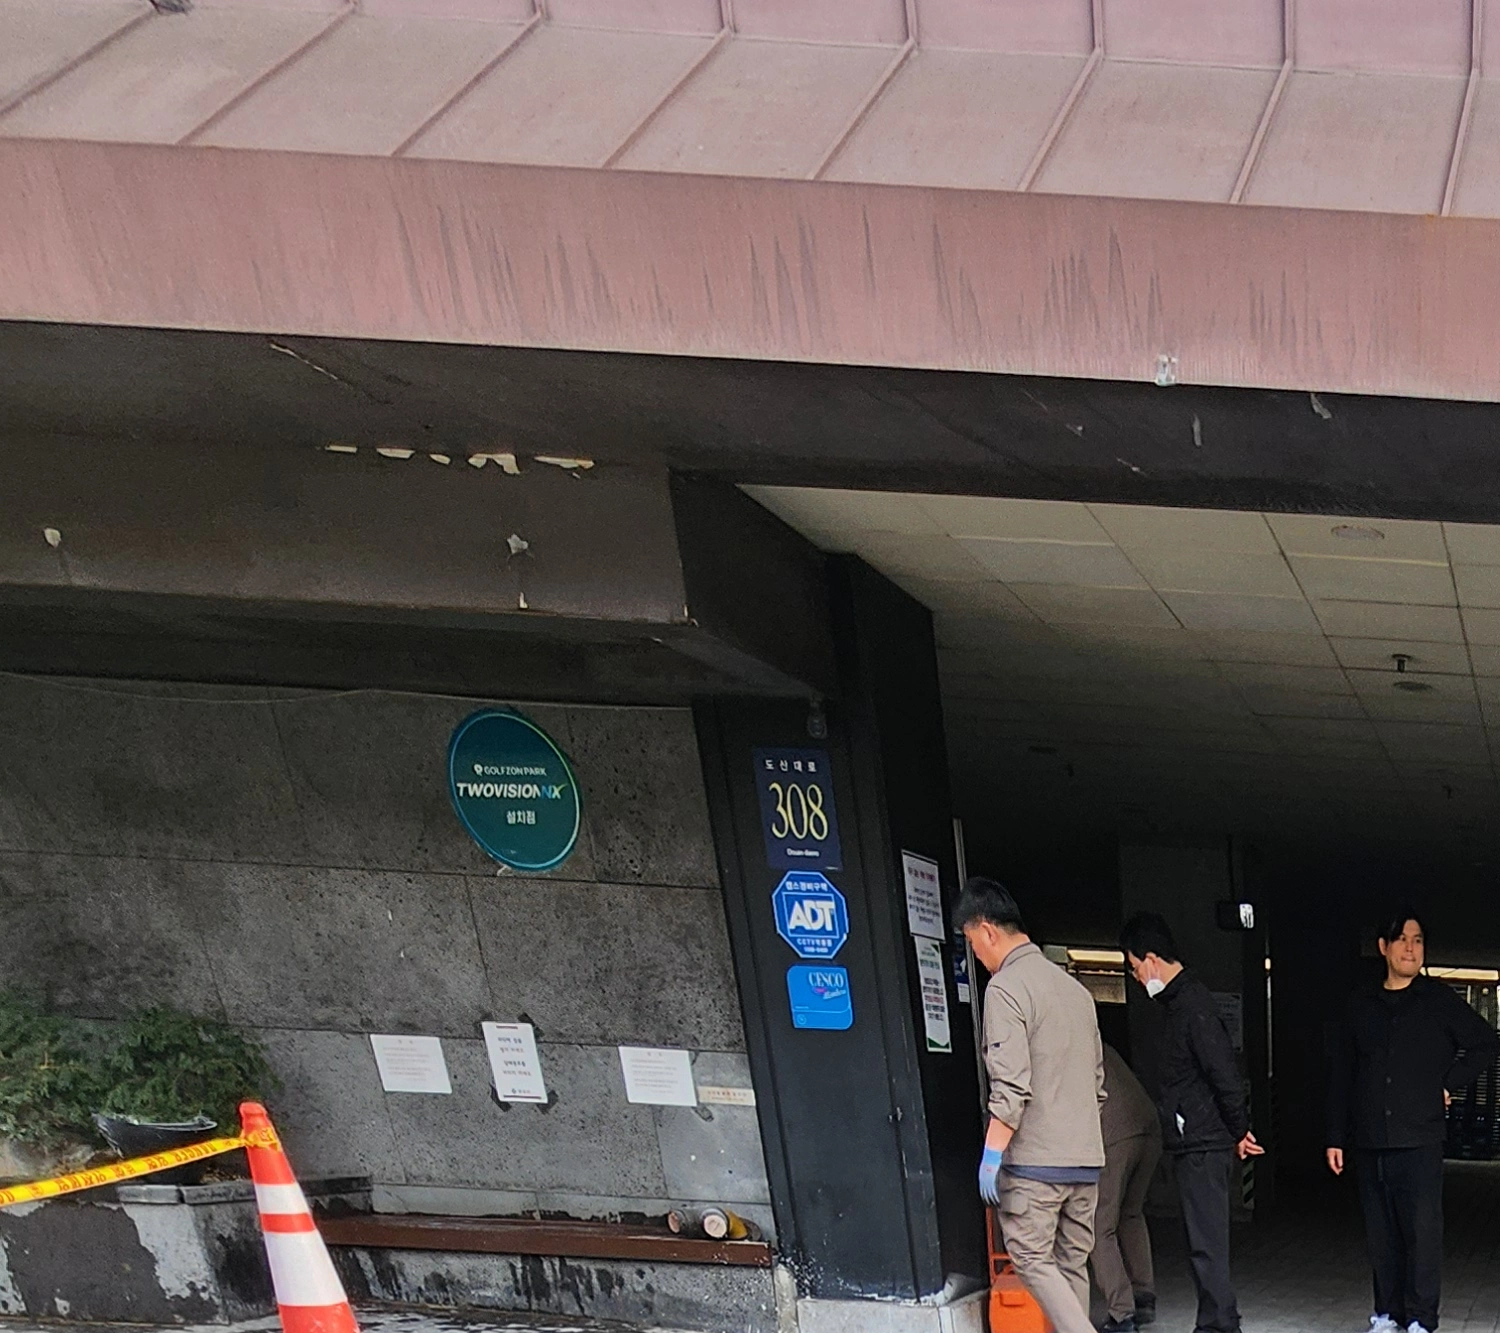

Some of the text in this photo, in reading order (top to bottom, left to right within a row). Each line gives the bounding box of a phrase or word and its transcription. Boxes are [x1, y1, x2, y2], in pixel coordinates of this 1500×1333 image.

[506, 810, 536, 825] 설치점
[768, 782, 828, 840] 308
[789, 899, 835, 931] ADT
